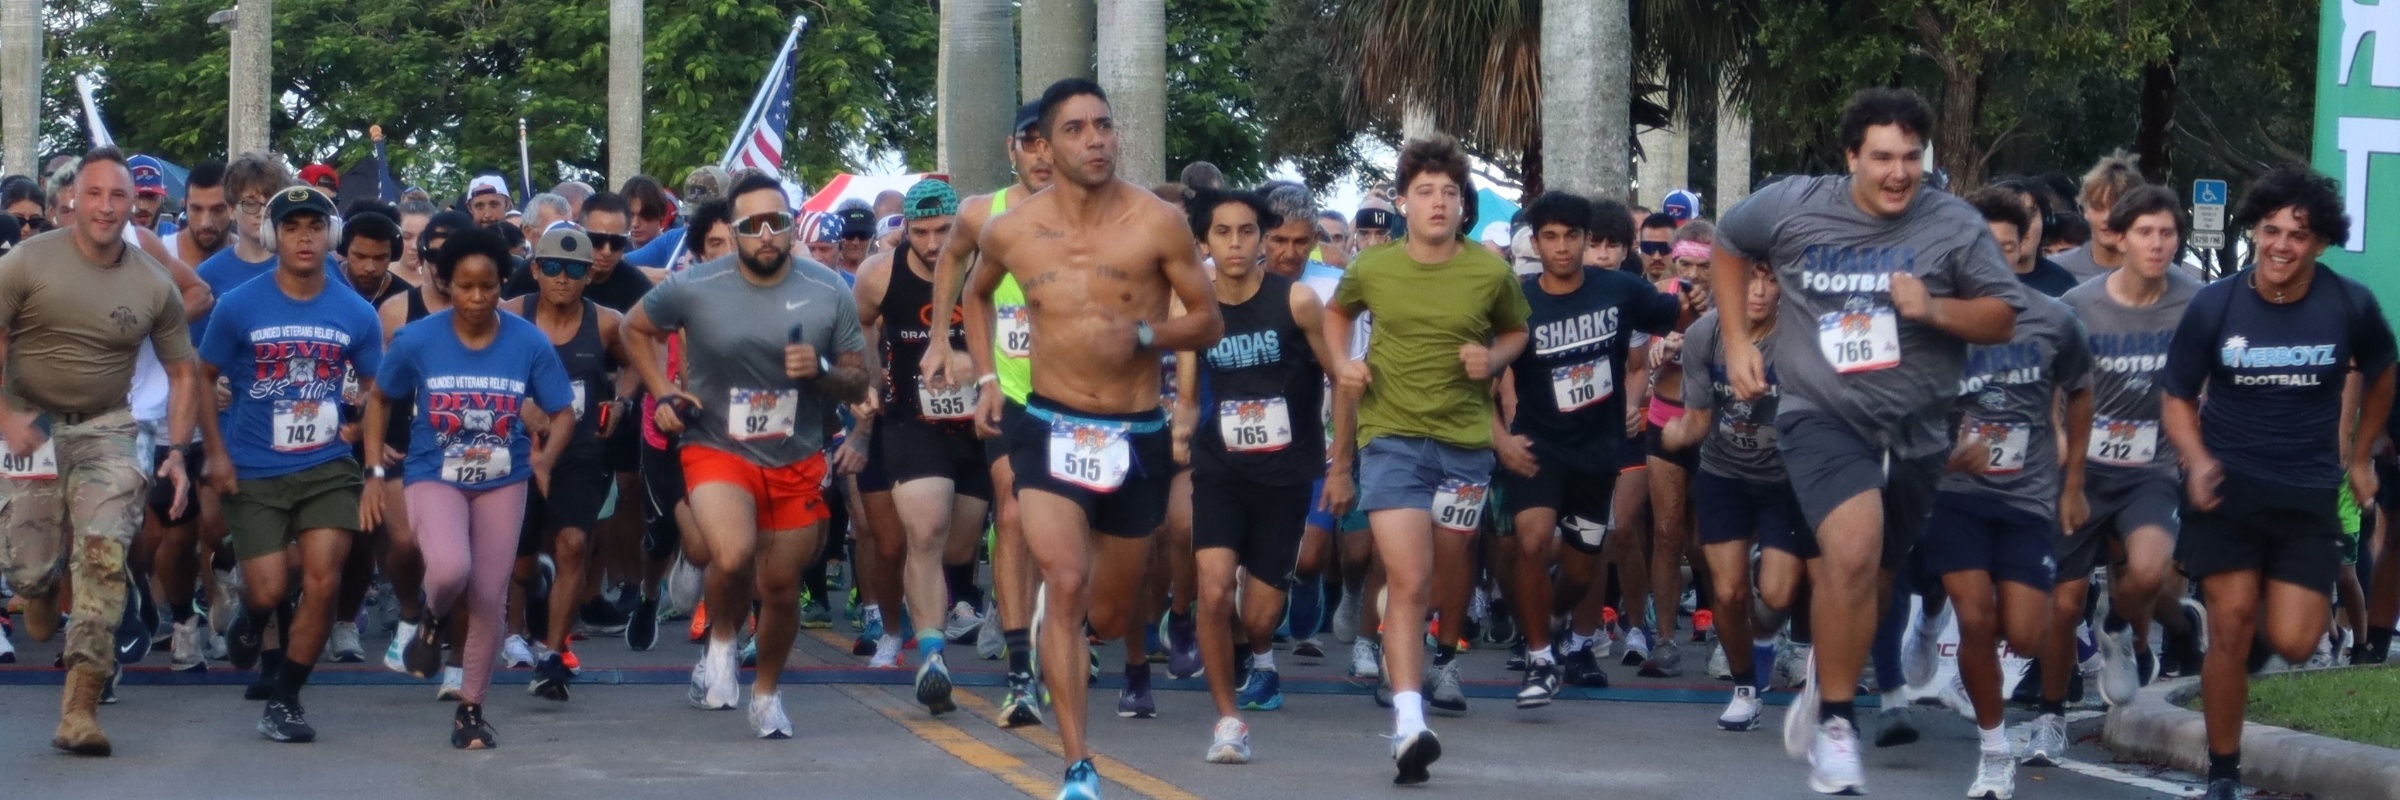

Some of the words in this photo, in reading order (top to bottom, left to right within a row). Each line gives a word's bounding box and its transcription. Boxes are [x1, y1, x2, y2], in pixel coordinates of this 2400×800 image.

[2210, 236, 2221, 244] FINE
[1802, 270, 1913, 292] FOOTBA
[250, 326, 281, 342] WOUNDED
[282, 325, 313, 337] VETERANS
[314, 326, 335, 340] RELIEF
[335, 332, 351, 346] FUND
[901, 330, 955, 339] ORAE
[1535, 306, 1619, 349] SHARKS
[254, 340, 342, 360] DEVIL
[1834, 339, 1873, 364] 766
[2221, 344, 2337, 368] RIVERBOYZ
[249, 379, 291, 399] 5K
[456, 375, 488, 389] VETERANS
[489, 376, 509, 390] RELIEF
[509, 380, 526, 394] FUND
[2234, 373, 2322, 386] FOOTBALL
[429, 391, 518, 413] DEVIL
[1567, 384, 1595, 404] 170
[930, 397, 964, 415] 535
[286, 424, 316, 444] 742
[746, 415, 768, 433] 92
[1233, 426, 1268, 445] 765
[1730, 433, 1759, 448] 215
[2099, 441, 2132, 460] 212
[455, 466, 487, 483] 125
[1064, 452, 1101, 482] 515
[1441, 505, 1476, 527] 910
